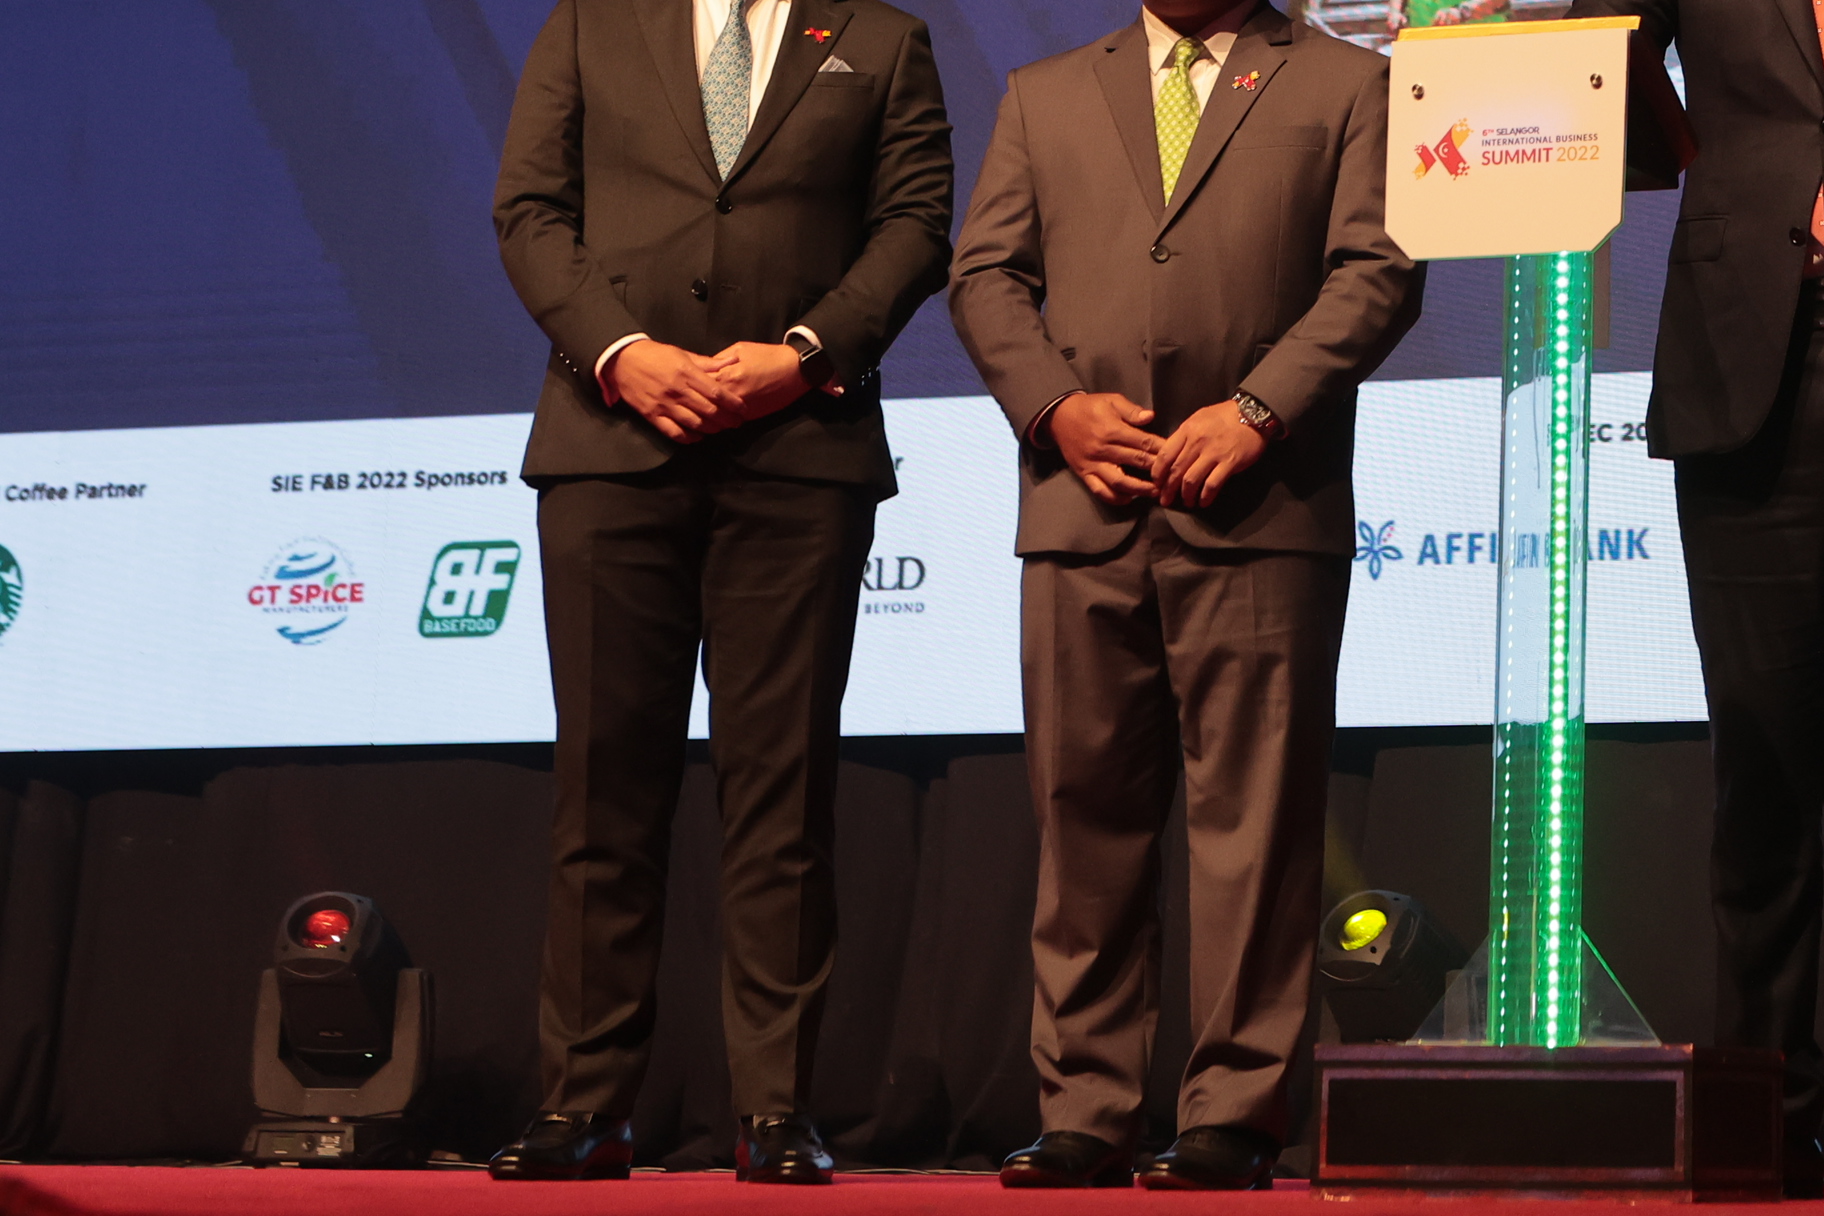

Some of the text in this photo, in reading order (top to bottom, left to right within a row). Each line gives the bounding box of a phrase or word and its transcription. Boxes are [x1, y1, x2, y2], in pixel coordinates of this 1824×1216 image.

[1481, 133, 1599, 147] INTERNATIONAL BUSINESS
[1496, 126, 1540, 136] SELANGOR
[1481, 145, 1600, 166] SUMMIT 2022
[271, 469, 508, 492] SIE F&B 2022 Sponsors
[5, 482, 147, 502] Coffee Partner
[1417, 532, 1497, 566] AFFI
[248, 585, 282, 606] GT
[864, 602, 925, 614] BEYOND
